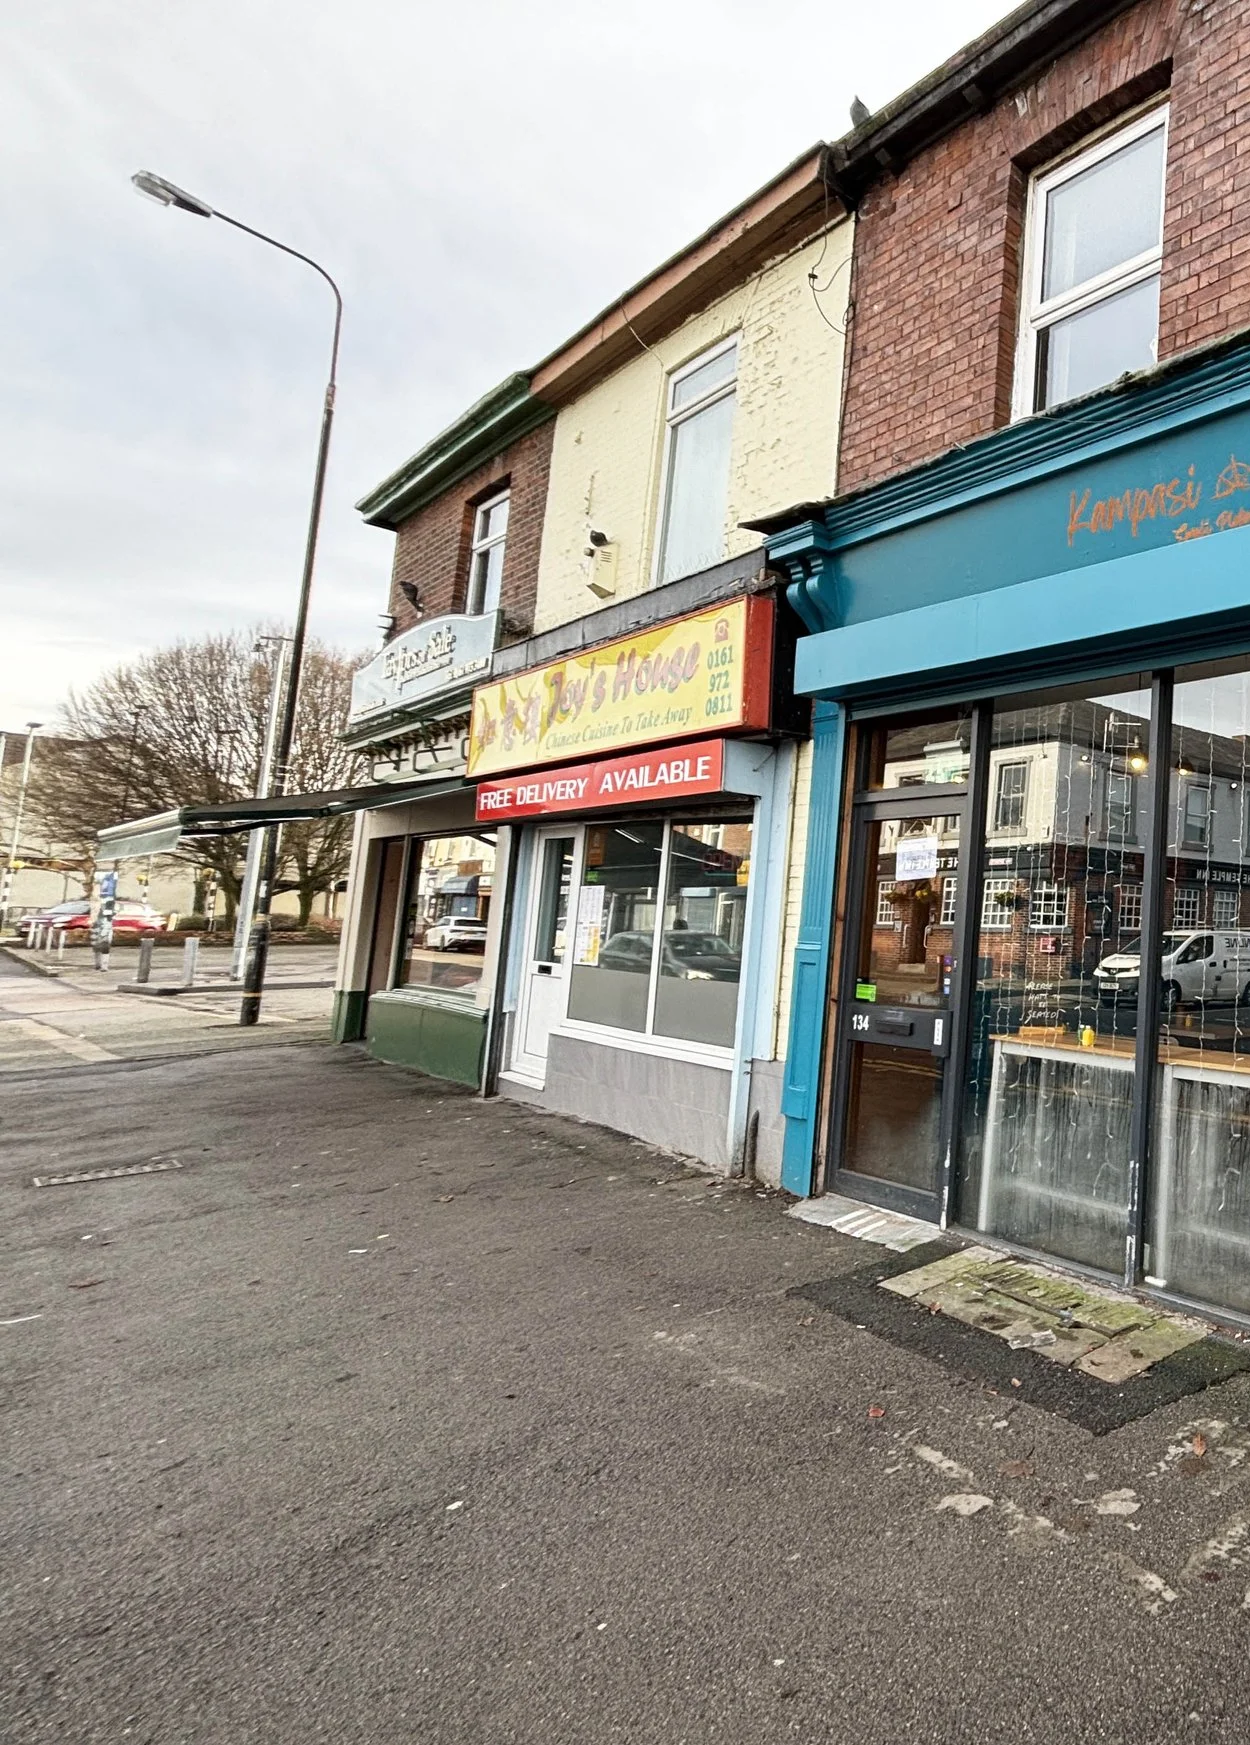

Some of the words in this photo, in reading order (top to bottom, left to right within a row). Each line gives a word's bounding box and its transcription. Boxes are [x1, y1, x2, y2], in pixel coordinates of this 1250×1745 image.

[1067, 463, 1201, 547] Kampasi
[707, 645, 734, 670] 0161
[546, 657, 606, 728] Joy's
[612, 641, 701, 703] House
[709, 671, 730, 693] 972
[705, 693, 733, 716] 0811
[545, 732, 580, 750] Chinese
[582, 722, 621, 742] Cuisine
[620, 716, 634, 735] To
[636, 710, 659, 731] Take
[661, 706, 693, 726] Away
[479, 788, 513, 811] FREE
[516, 777, 590, 806] DELIVERY
[599, 756, 713, 794] AVAILABLE
[852, 1014, 870, 1031] 134
